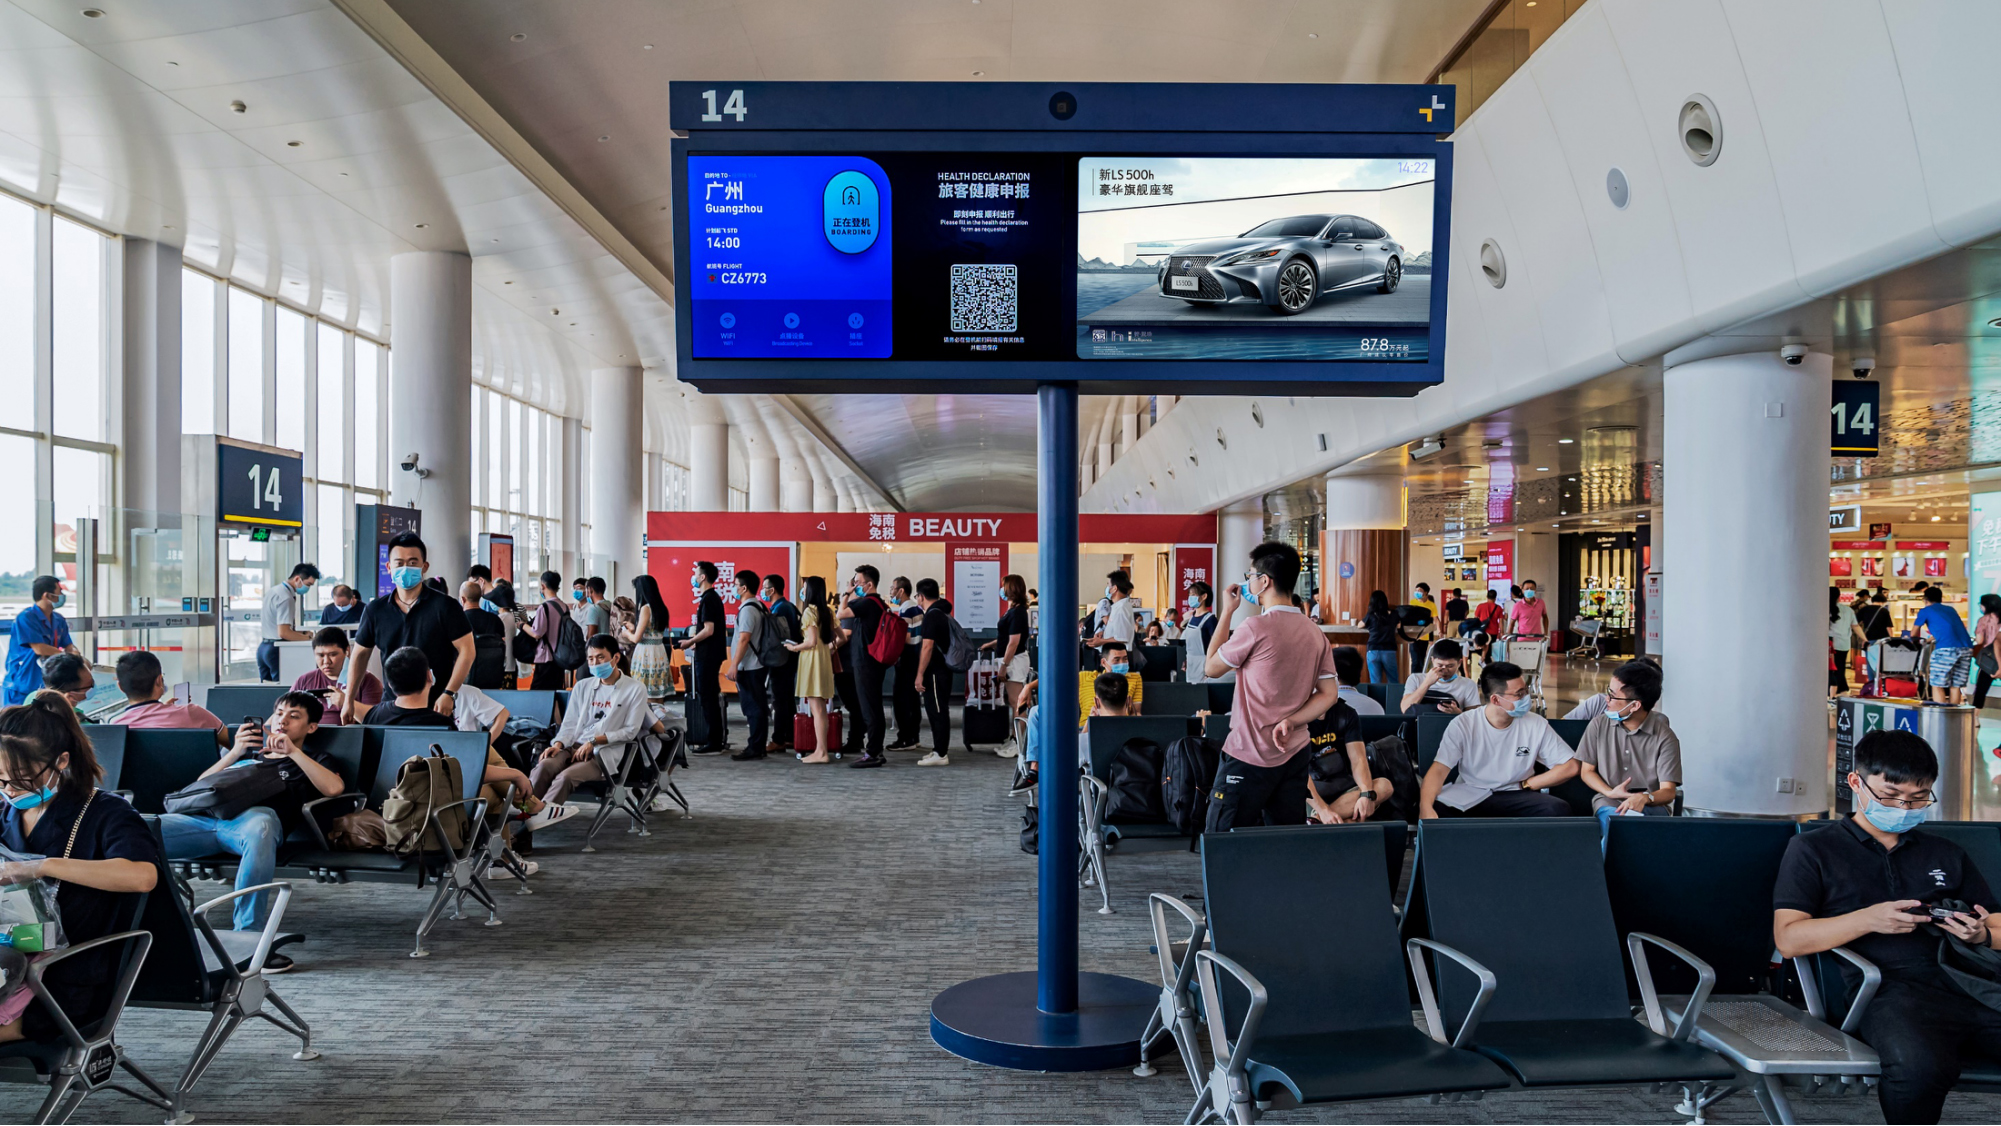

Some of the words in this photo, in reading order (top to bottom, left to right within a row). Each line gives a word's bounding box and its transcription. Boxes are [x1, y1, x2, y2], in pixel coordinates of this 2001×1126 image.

[702, 89, 748, 122] 14
[1398, 162, 1428, 173] 14:22
[938, 172, 970, 180] HEALTH
[972, 172, 1030, 180] DECLARATION
[1126, 170, 1154, 180] 500h
[706, 180, 742, 200] 广州
[938, 182, 1030, 199] 旅客健康申报
[1100, 184, 1174, 196] 豪华旗舰座驾
[706, 203, 763, 215] Guangzhou
[954, 210, 984, 218] 即刻申报
[984, 210, 1015, 218] 顺利出行
[832, 218, 870, 228] 正在登机
[706, 237, 740, 248] 14:00
[721, 272, 767, 284] CZ6773
[1830, 402, 1874, 435] 14
[248, 464, 282, 512] 14
[869, 514, 896, 526] 海南
[909, 518, 1002, 536] BEAUTY
[869, 527, 896, 540] 免税
[1444, 547, 1458, 555] BEAUTY
[1183, 568, 1206, 579] 海南
